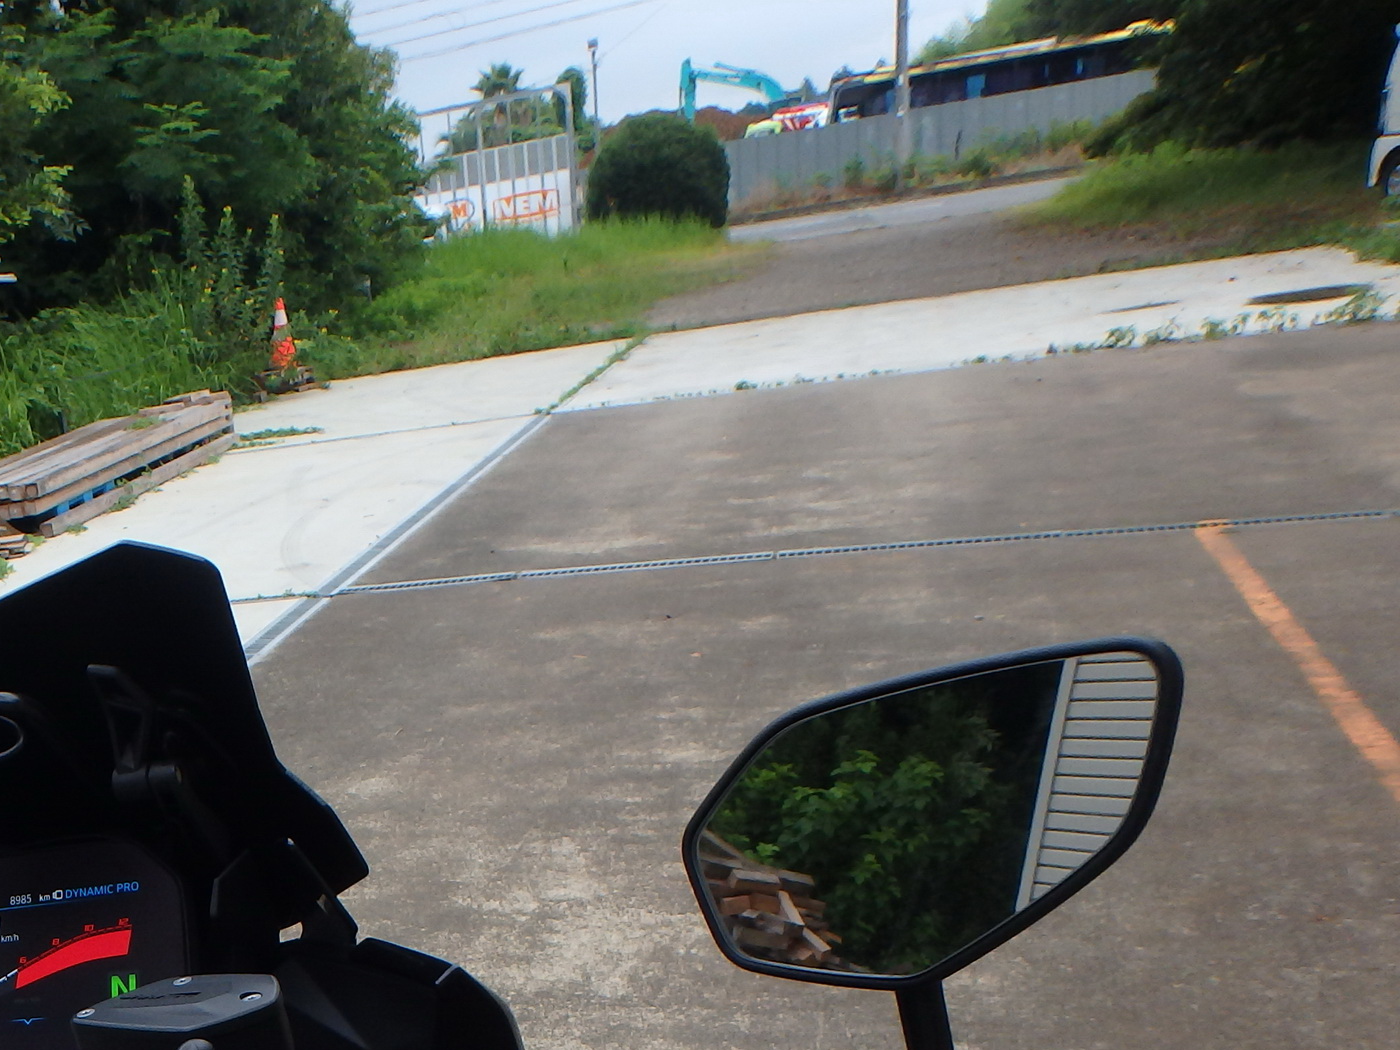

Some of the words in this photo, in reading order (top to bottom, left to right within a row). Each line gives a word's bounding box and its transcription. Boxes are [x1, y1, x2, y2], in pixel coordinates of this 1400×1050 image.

[65, 884, 114, 898] DYNAMIC
[116, 881, 139, 892] PRO
[10, 894, 32, 906] 8985
[39, 894, 50, 902] km
[118, 917, 129, 926] 12
[111, 974, 137, 998] N
